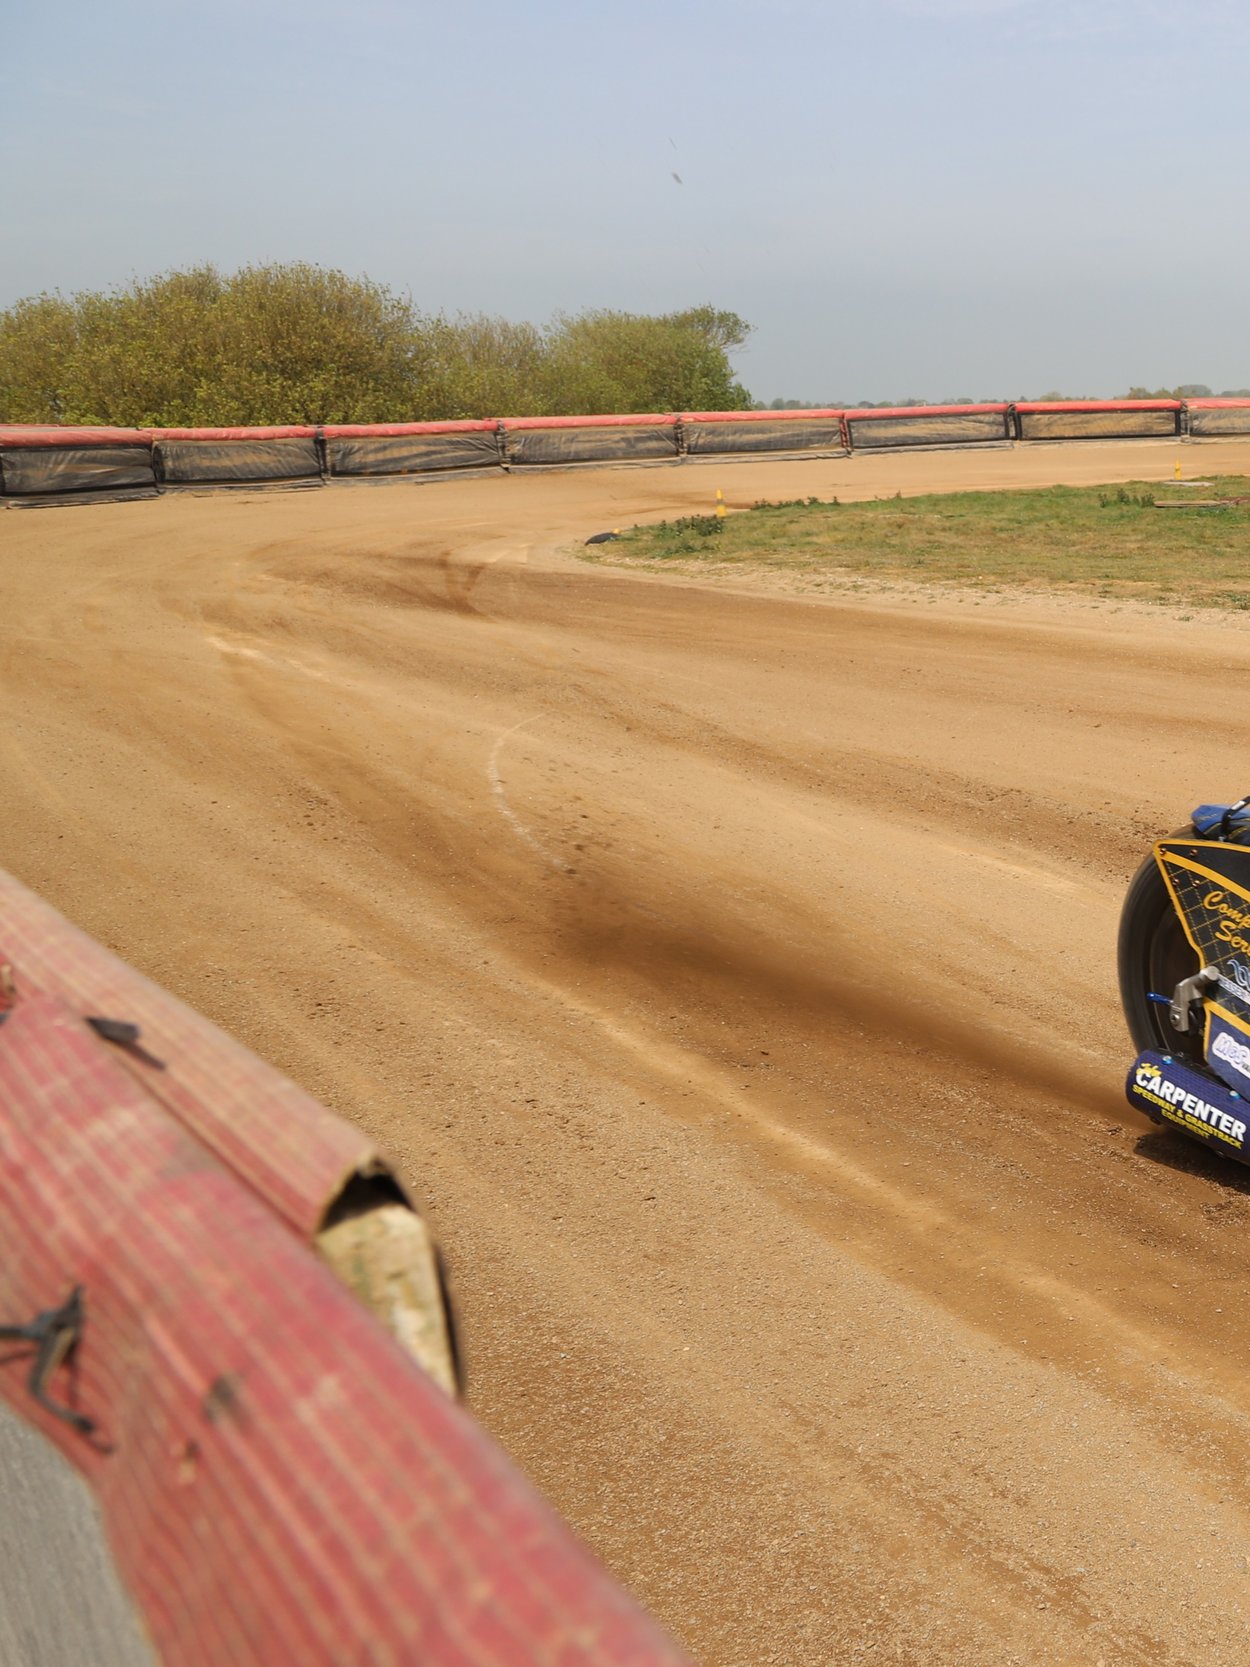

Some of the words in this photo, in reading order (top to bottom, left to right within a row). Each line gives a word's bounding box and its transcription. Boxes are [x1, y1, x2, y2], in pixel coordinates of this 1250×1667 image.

[1132, 1084, 1176, 1113] SPEEDWAY
[1185, 1113, 1243, 1149] GRASSTRACK
[1136, 1071, 1247, 1142] CARPENTER
